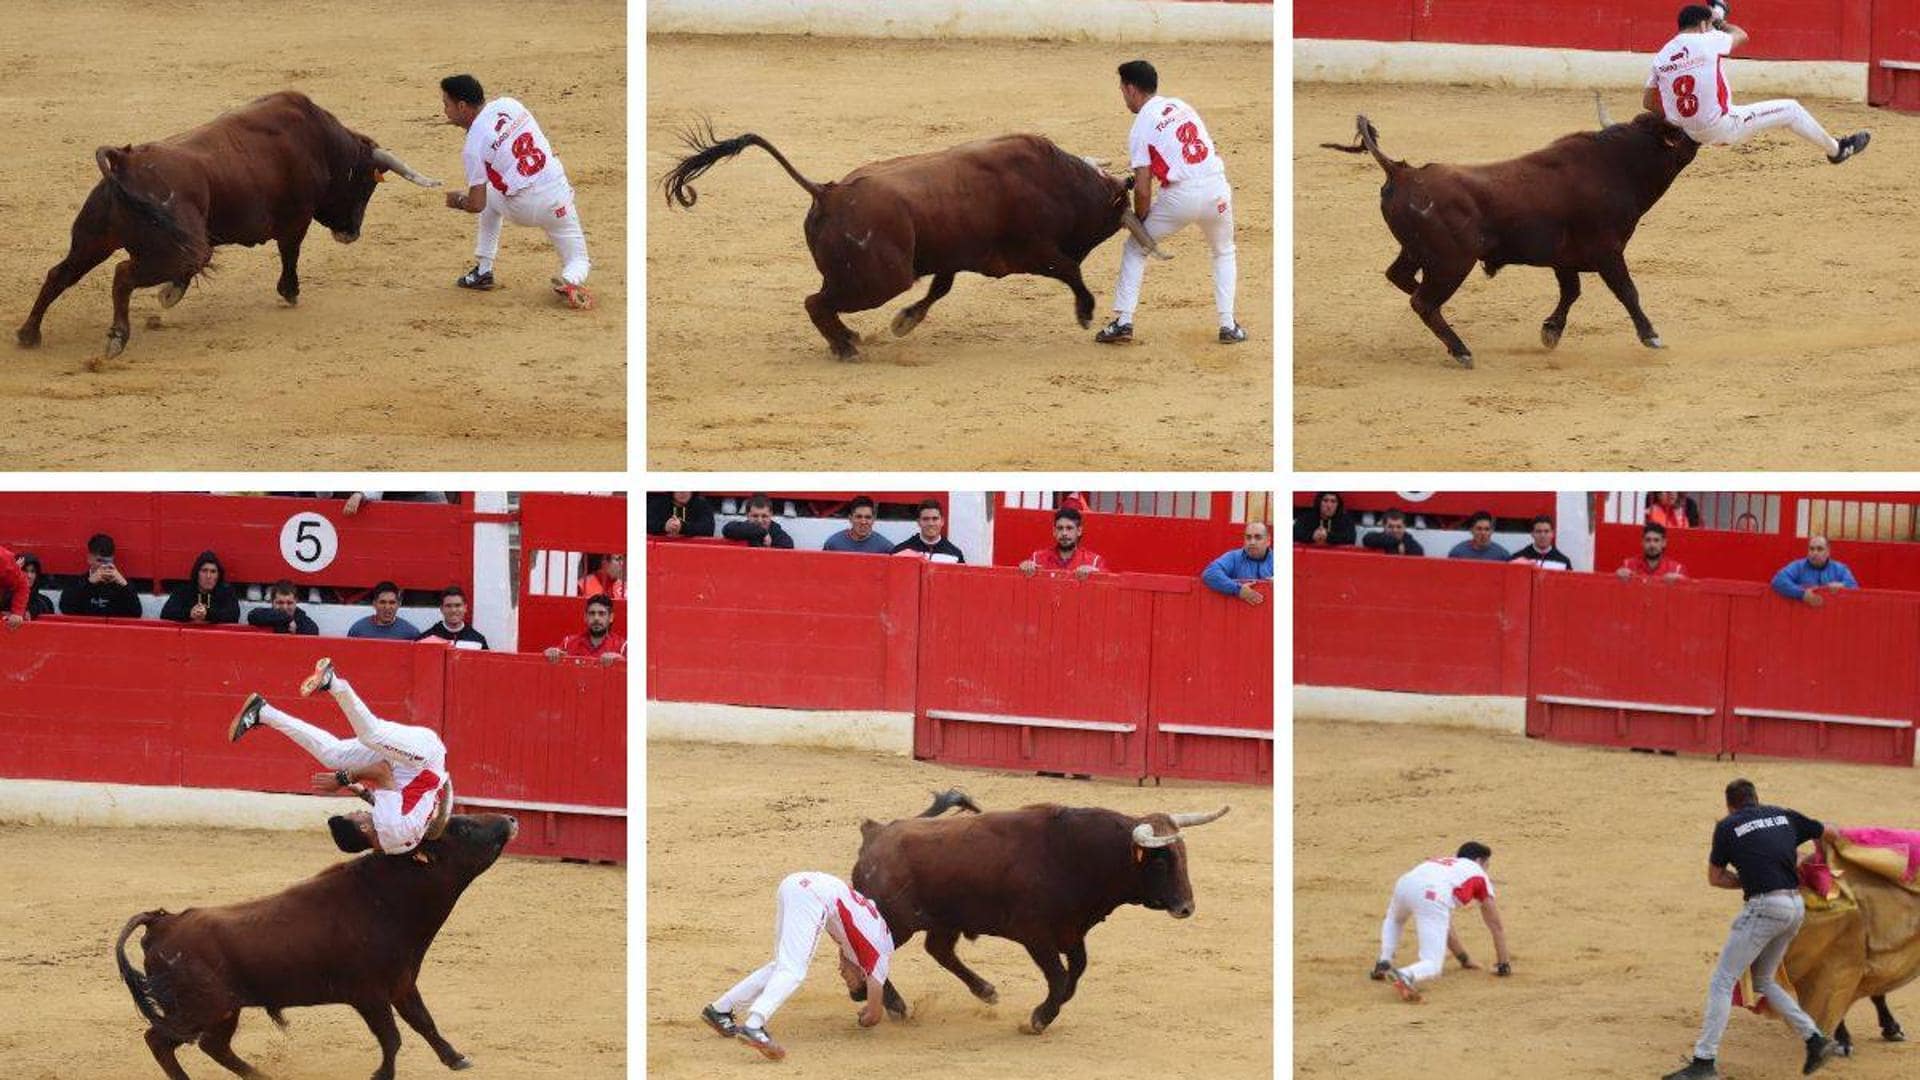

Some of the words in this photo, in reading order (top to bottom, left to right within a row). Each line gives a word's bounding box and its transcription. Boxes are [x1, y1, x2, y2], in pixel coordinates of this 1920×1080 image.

[1673, 75, 1698, 117] 8
[512, 132, 546, 177] 8
[1176, 121, 1208, 164] 8
[295, 520, 322, 563] 5
